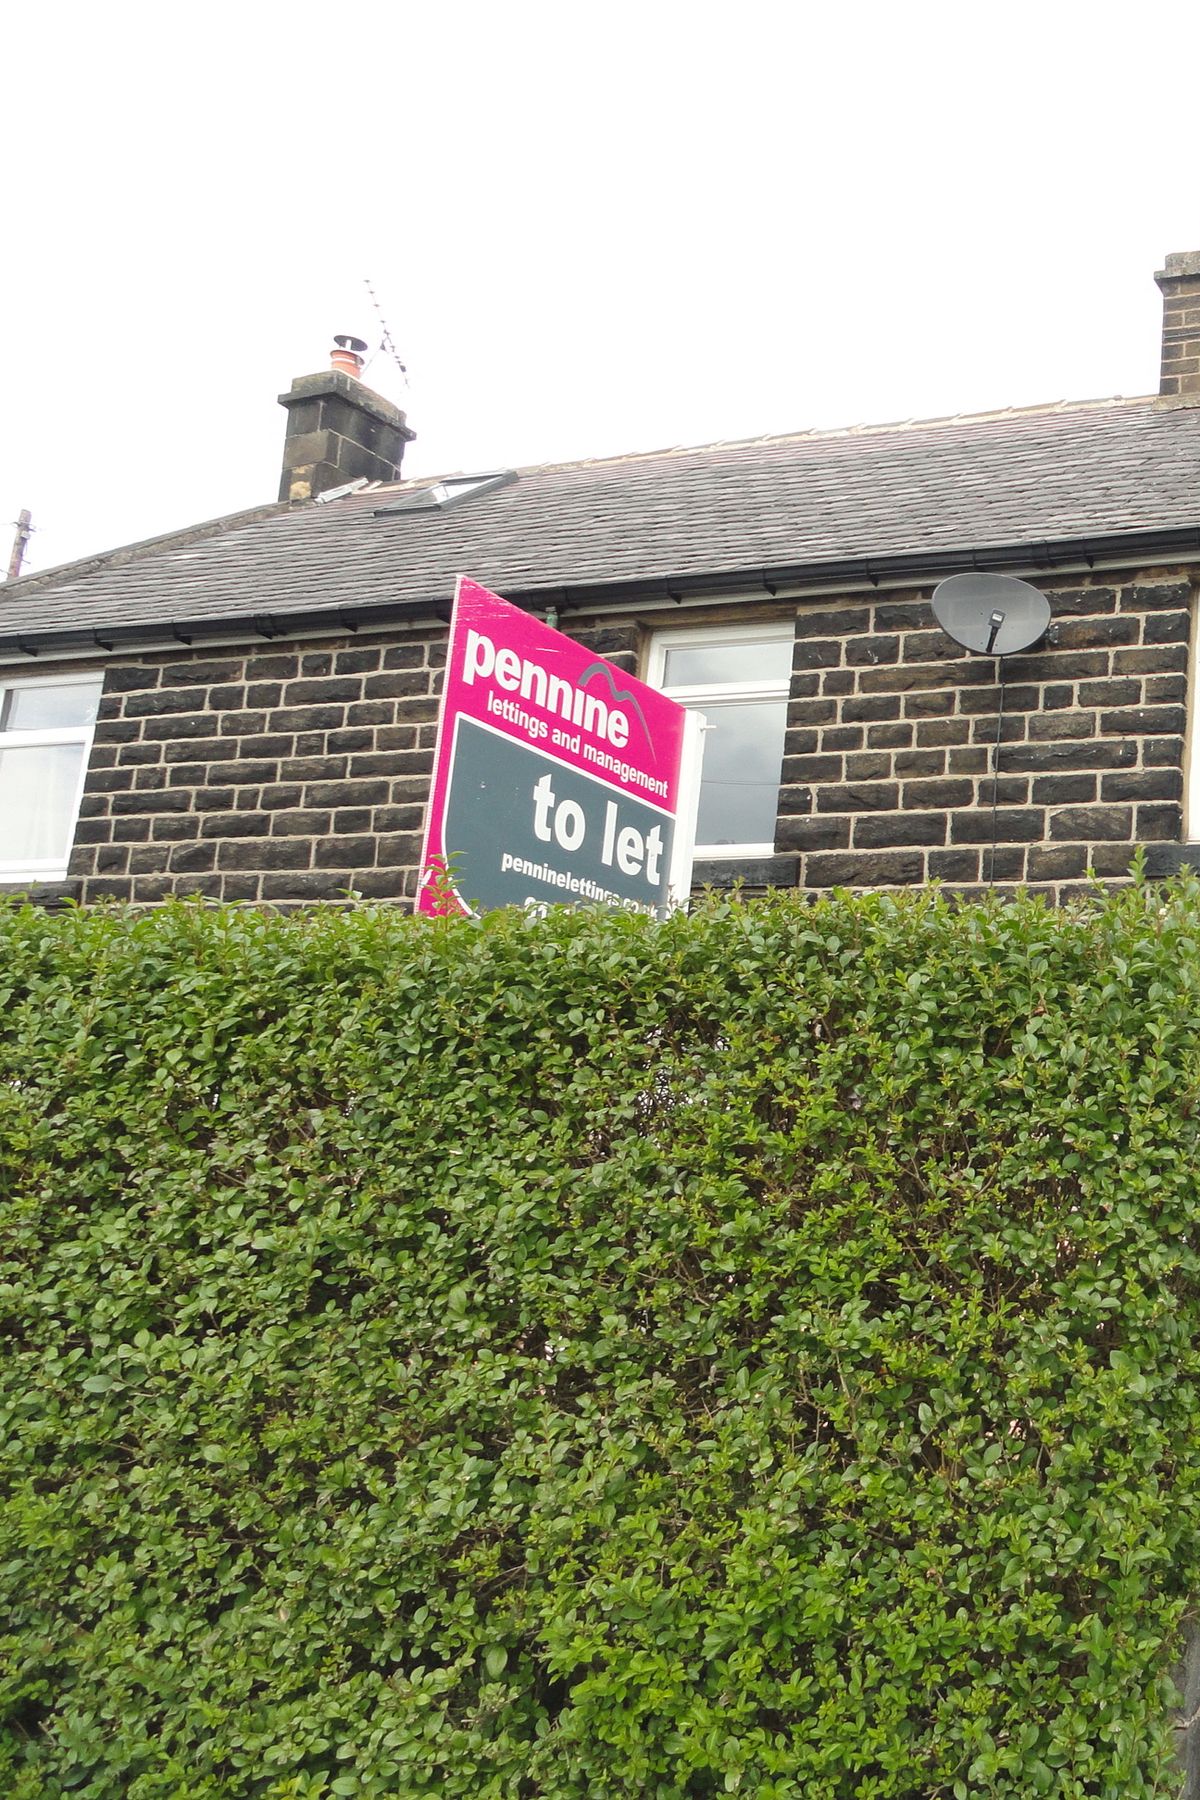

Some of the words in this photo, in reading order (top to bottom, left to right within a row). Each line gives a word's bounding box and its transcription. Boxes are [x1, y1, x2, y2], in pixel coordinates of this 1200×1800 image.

[462, 628, 630, 748] pennine
[487, 689, 548, 739] lettings
[552, 728, 581, 754] and
[583, 743, 669, 798] management
[533, 774, 586, 851] to
[601, 800, 664, 886] let
